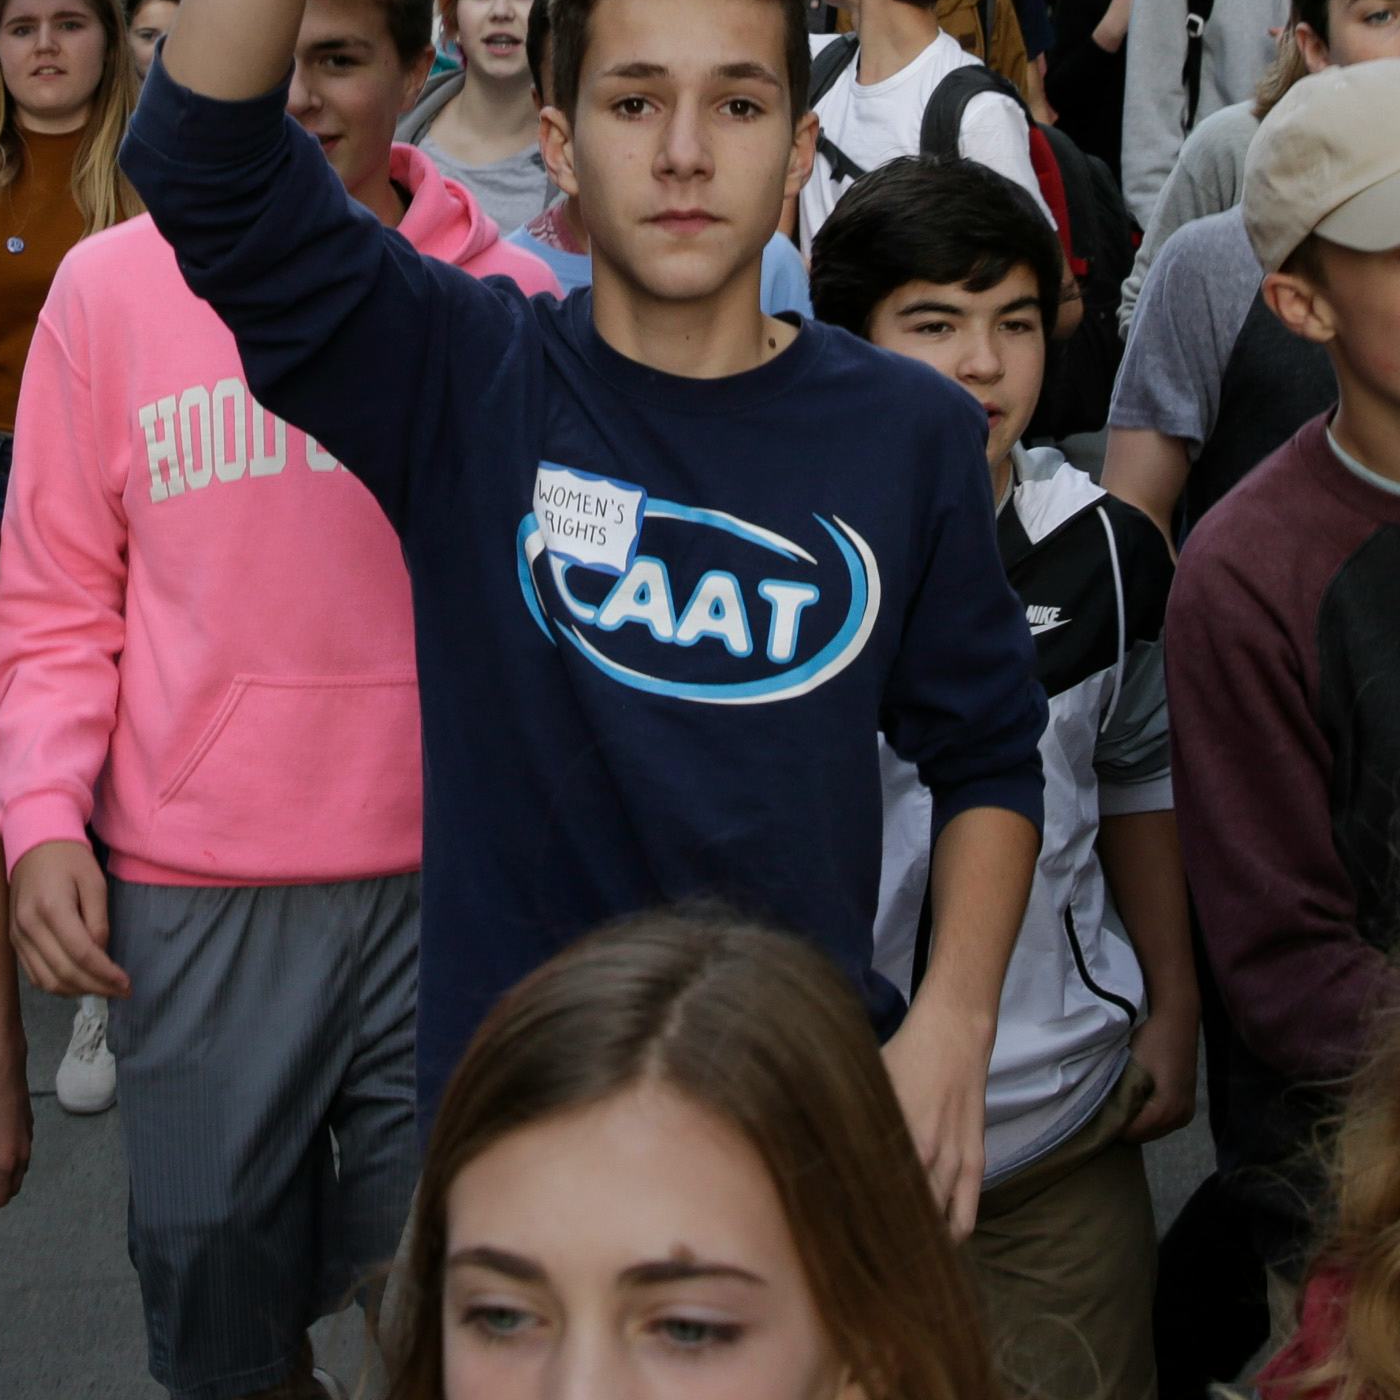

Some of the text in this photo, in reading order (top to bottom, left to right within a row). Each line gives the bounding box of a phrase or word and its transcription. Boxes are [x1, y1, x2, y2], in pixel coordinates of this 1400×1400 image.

[139, 377, 287, 504] HOOD
[538, 479, 625, 525] WOMEN'S
[545, 510, 607, 547] RIGHTS
[1025, 604, 1062, 624] NIKE
